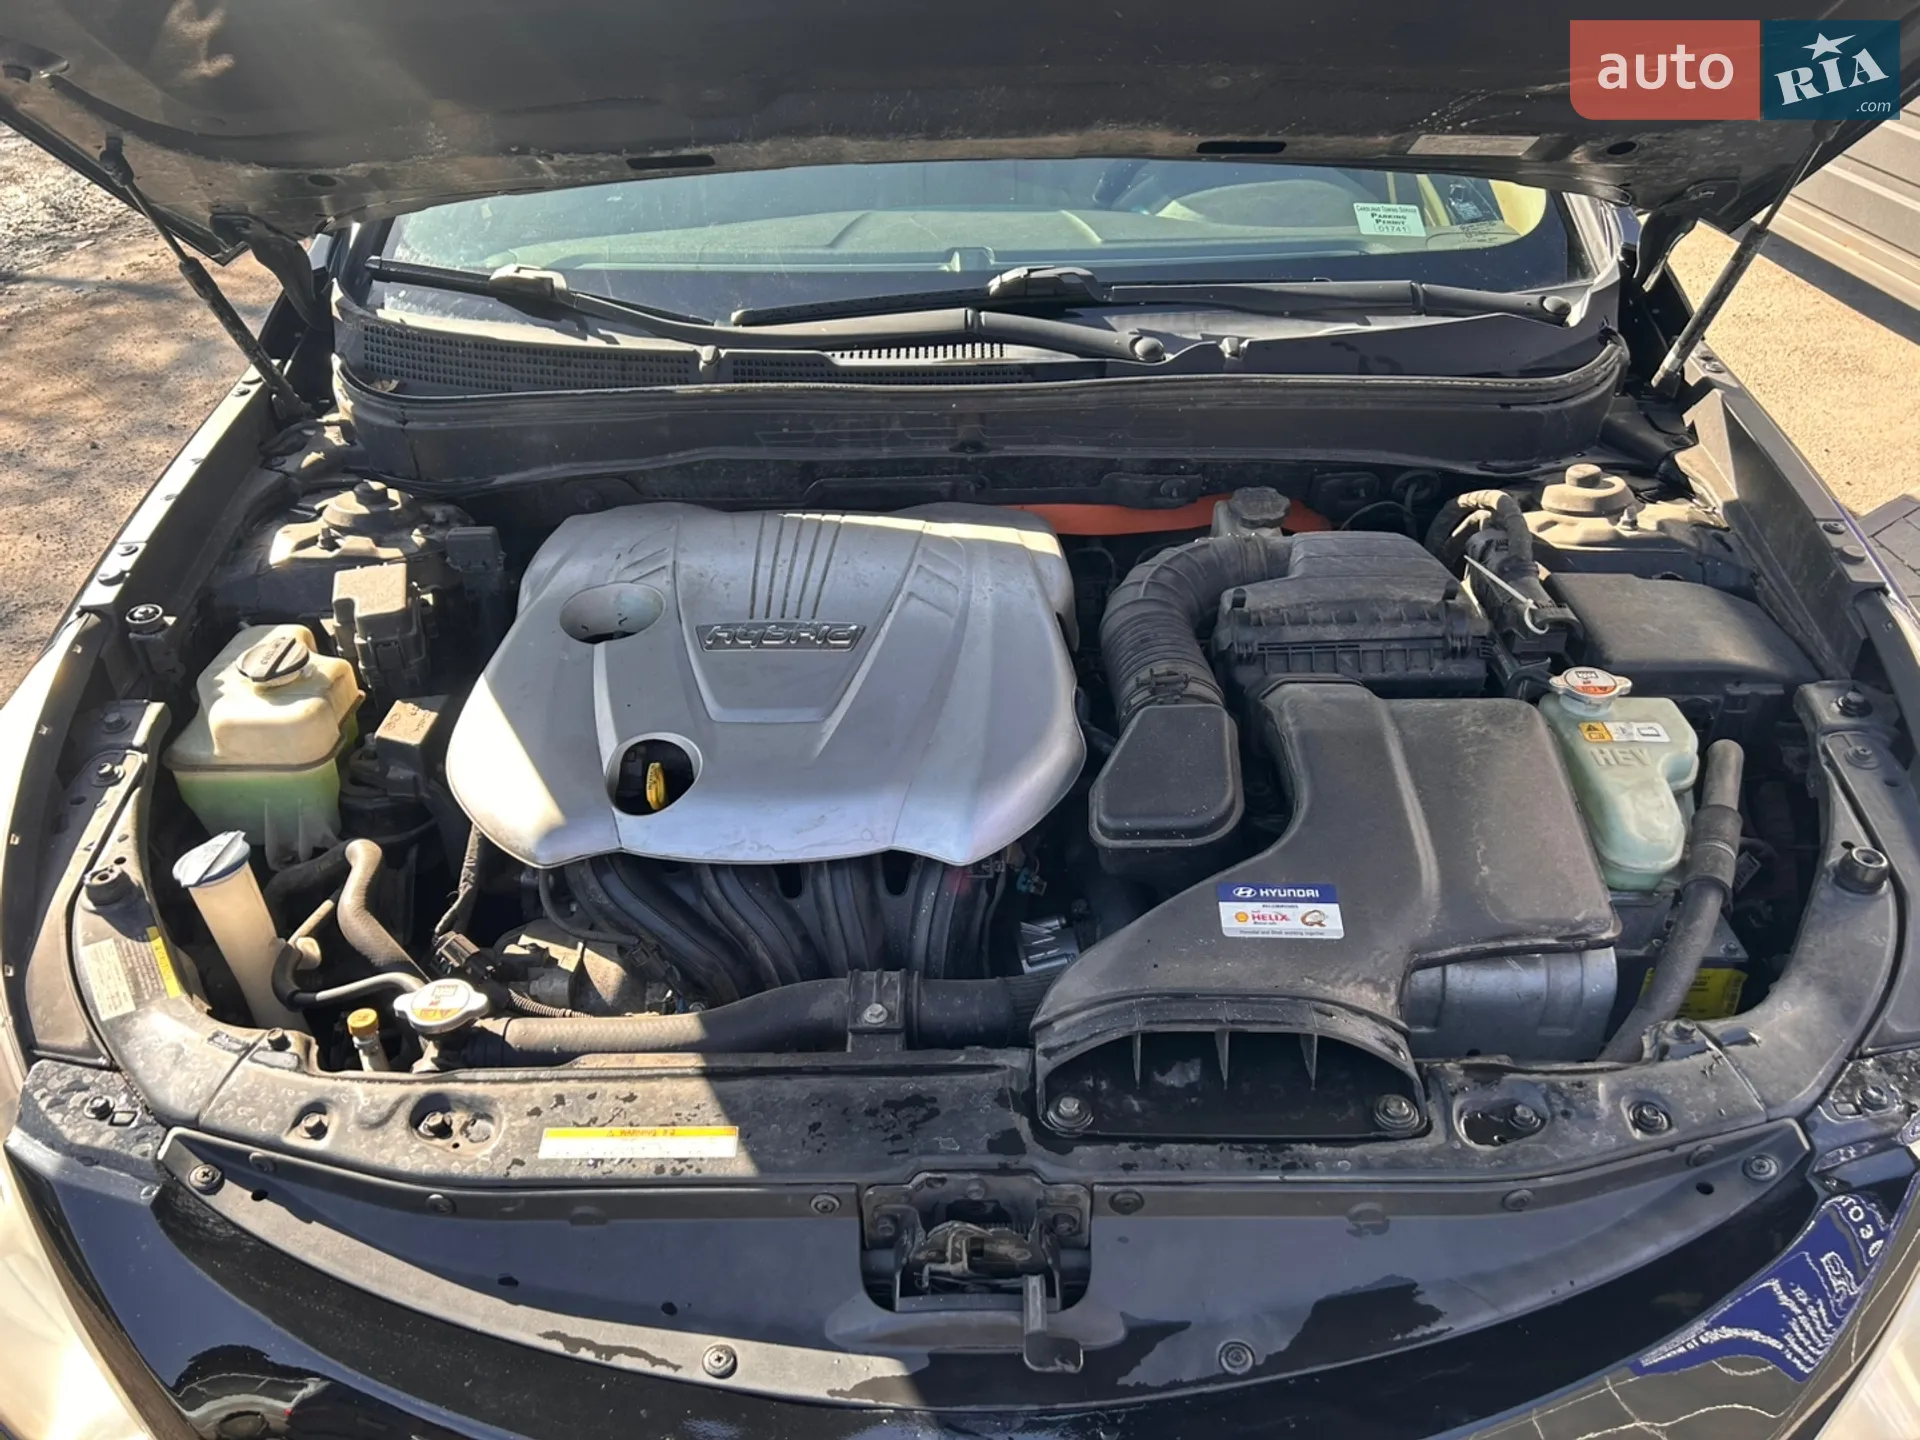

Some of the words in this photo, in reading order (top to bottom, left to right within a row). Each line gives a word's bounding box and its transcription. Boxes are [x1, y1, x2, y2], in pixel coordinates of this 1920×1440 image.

[1370, 212, 1407, 220] PARKING
[1590, 741, 1651, 767] HEV
[1260, 888, 1319, 898] HYUNDAI
[1252, 913, 1289, 922] HELIX
